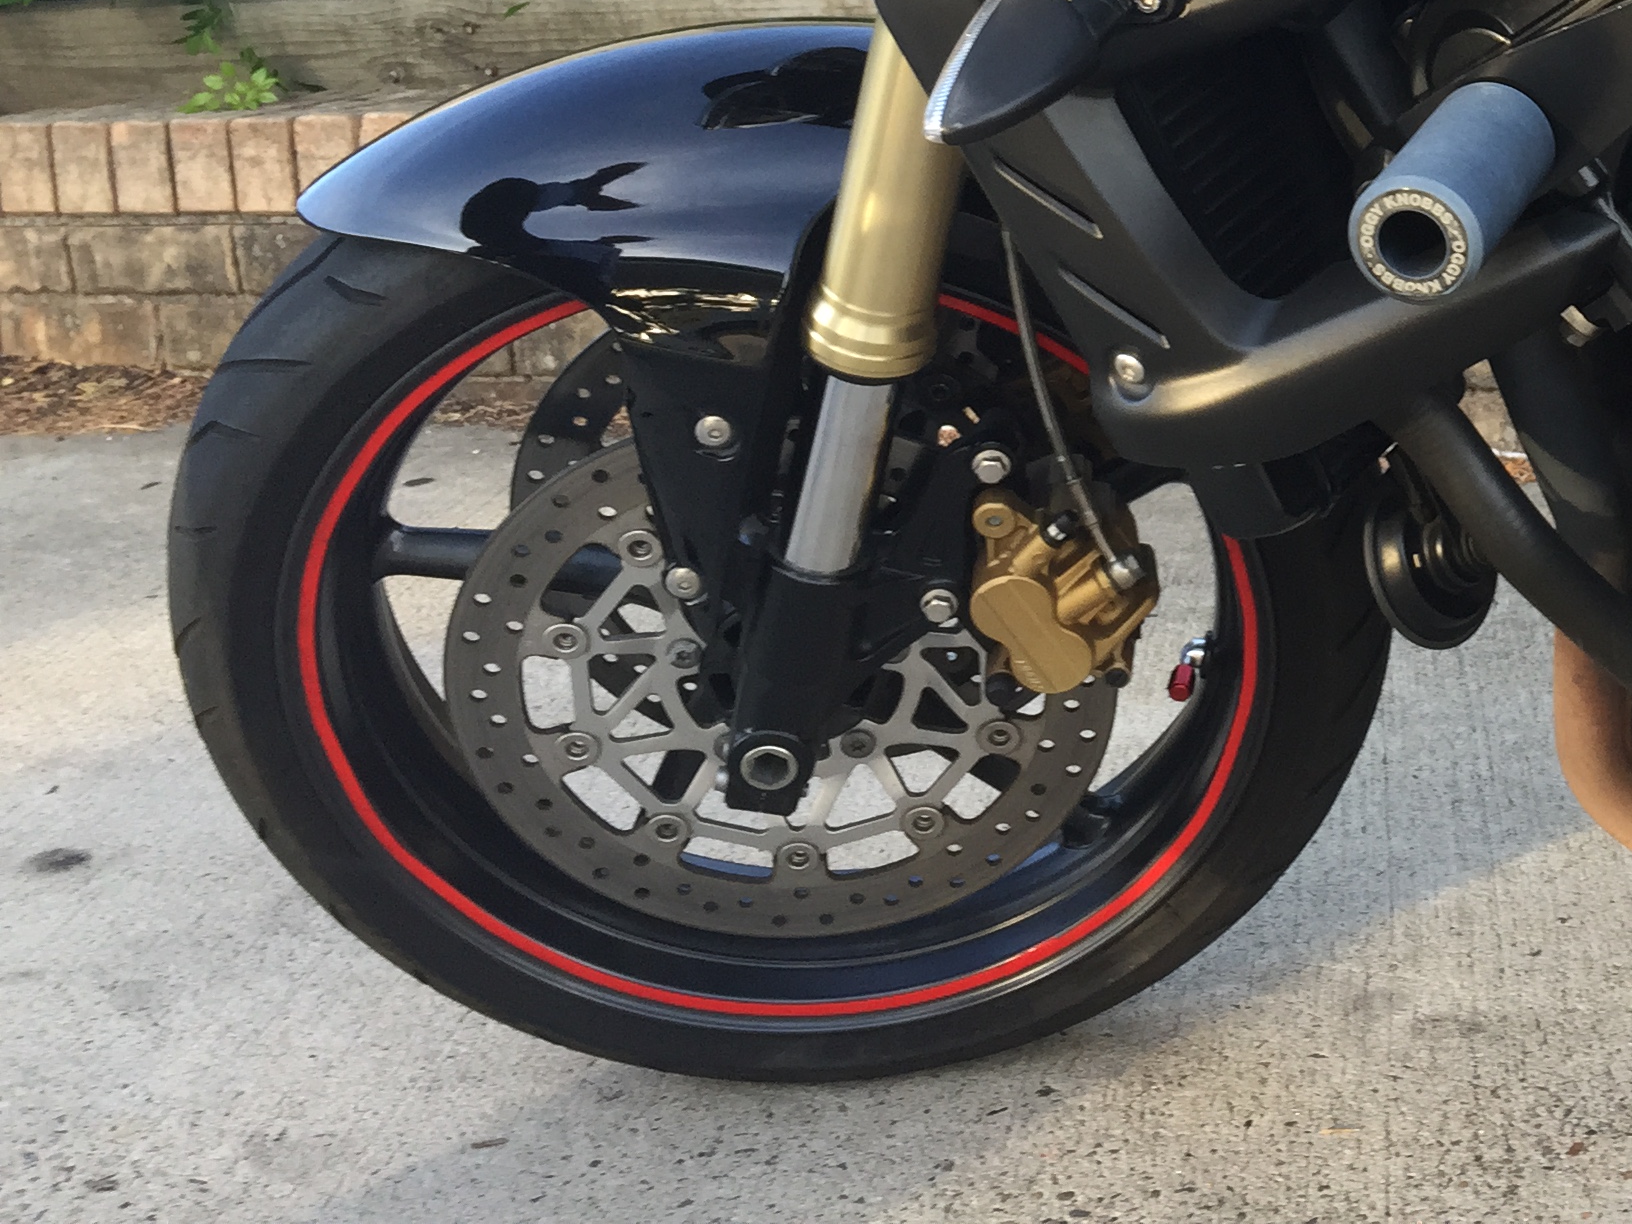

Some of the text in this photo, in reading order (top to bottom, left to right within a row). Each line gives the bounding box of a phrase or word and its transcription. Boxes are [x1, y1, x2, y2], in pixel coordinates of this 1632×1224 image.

[1360, 192, 1454, 248] OGGY KNOBBS
[1371, 240, 1467, 294] OGGY KNOBBS
